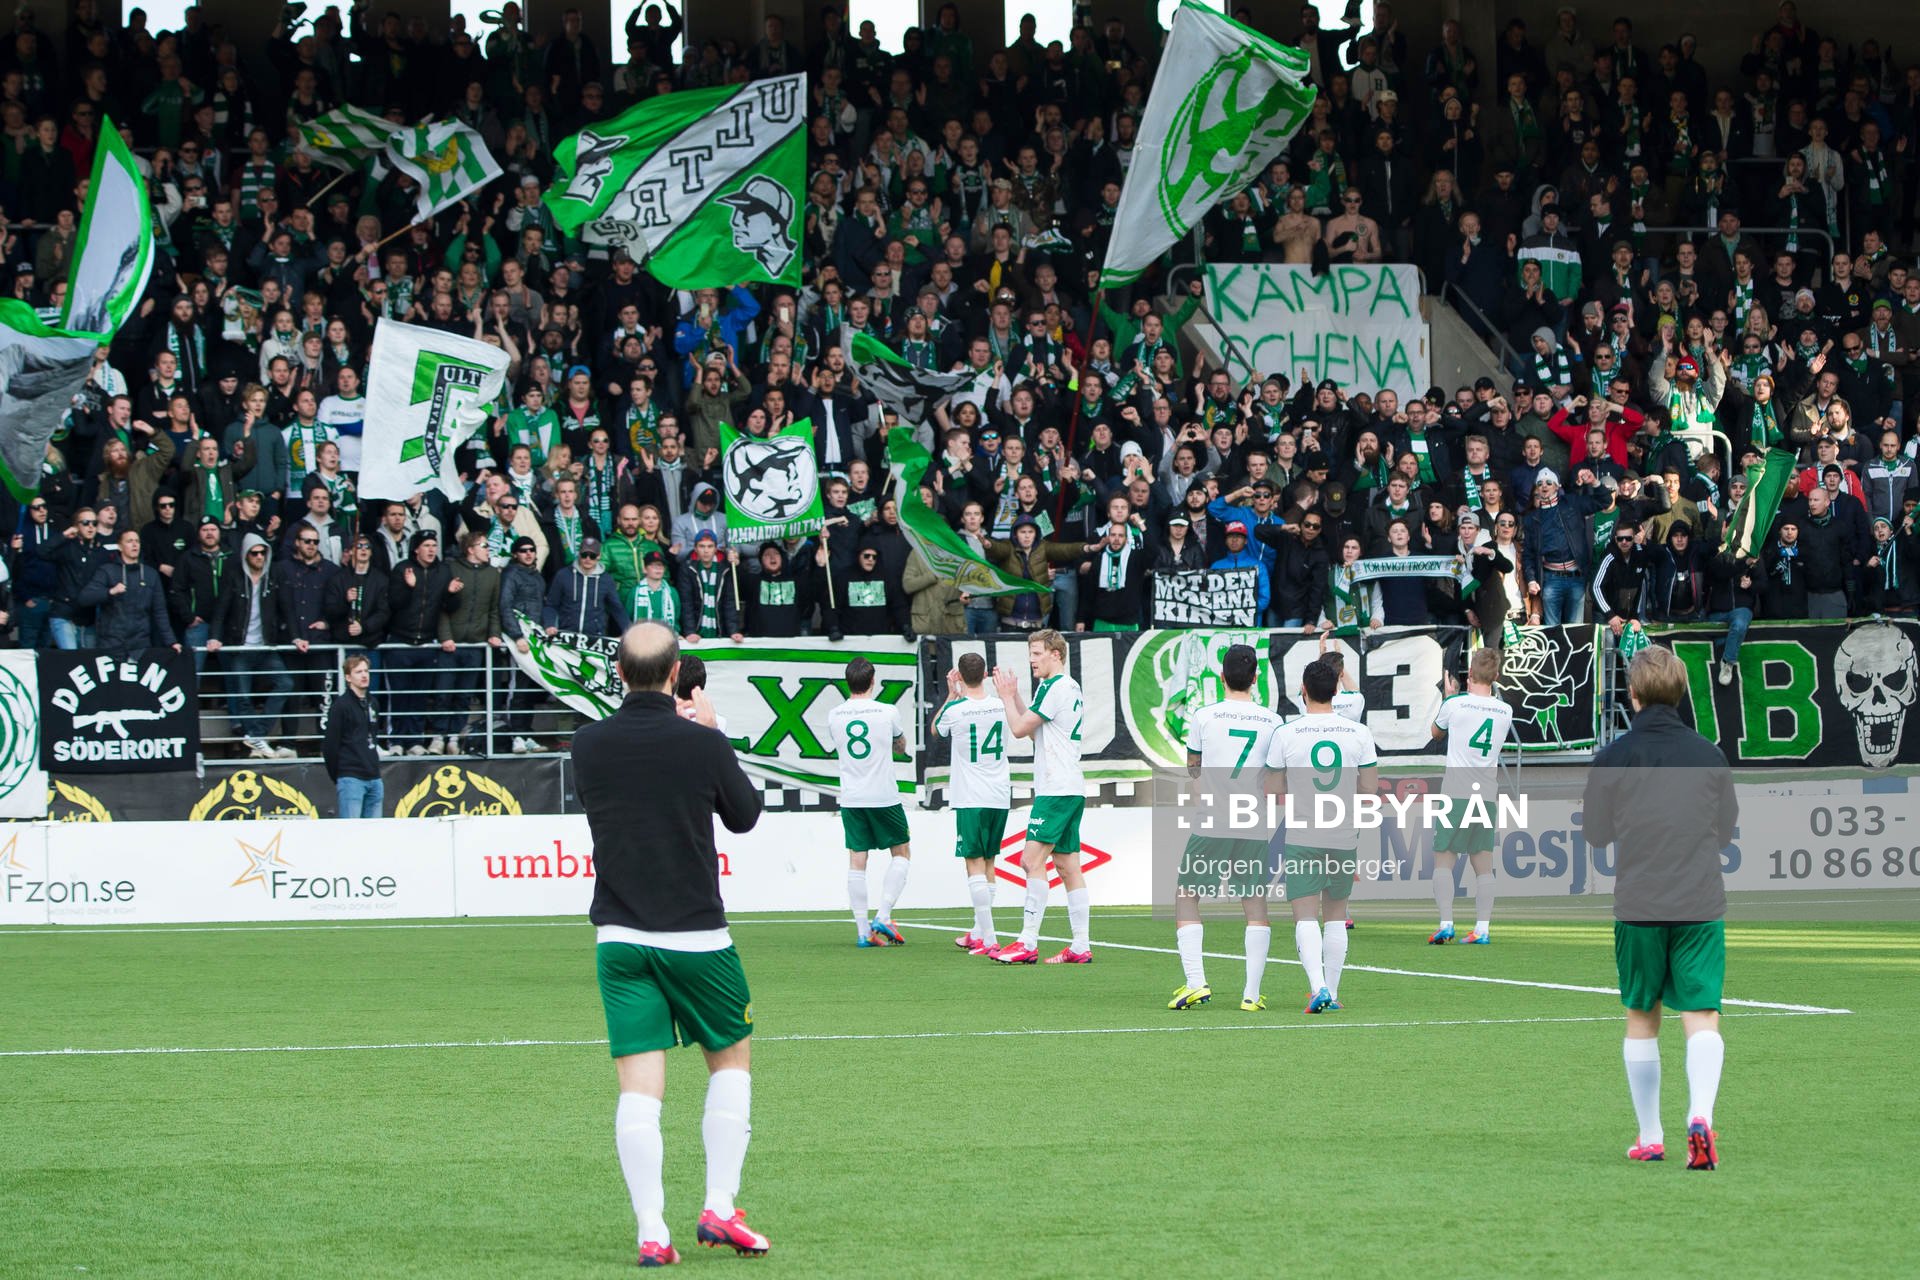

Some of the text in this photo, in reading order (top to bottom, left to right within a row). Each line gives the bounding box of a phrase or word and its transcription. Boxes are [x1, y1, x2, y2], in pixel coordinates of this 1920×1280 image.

[1206, 263, 1411, 322] KÄMPA
[1207, 569, 1256, 592] DEN
[51, 655, 186, 714] DEFEND
[1213, 711, 1238, 721] Sefina
[1295, 726, 1320, 735] Sefina
[53, 736, 187, 762] SÖDERORT
[845, 719, 872, 760] 8
[969, 720, 1004, 763] 14
[1228, 728, 1258, 780] 7
[1468, 718, 1495, 757] 4
[1310, 740, 1343, 792] 9
[1768, 849, 1812, 879] 10
[1823, 847, 1872, 879] 86
[7, 874, 136, 903] Fzon.se
[271, 870, 398, 899] Fzon.se
